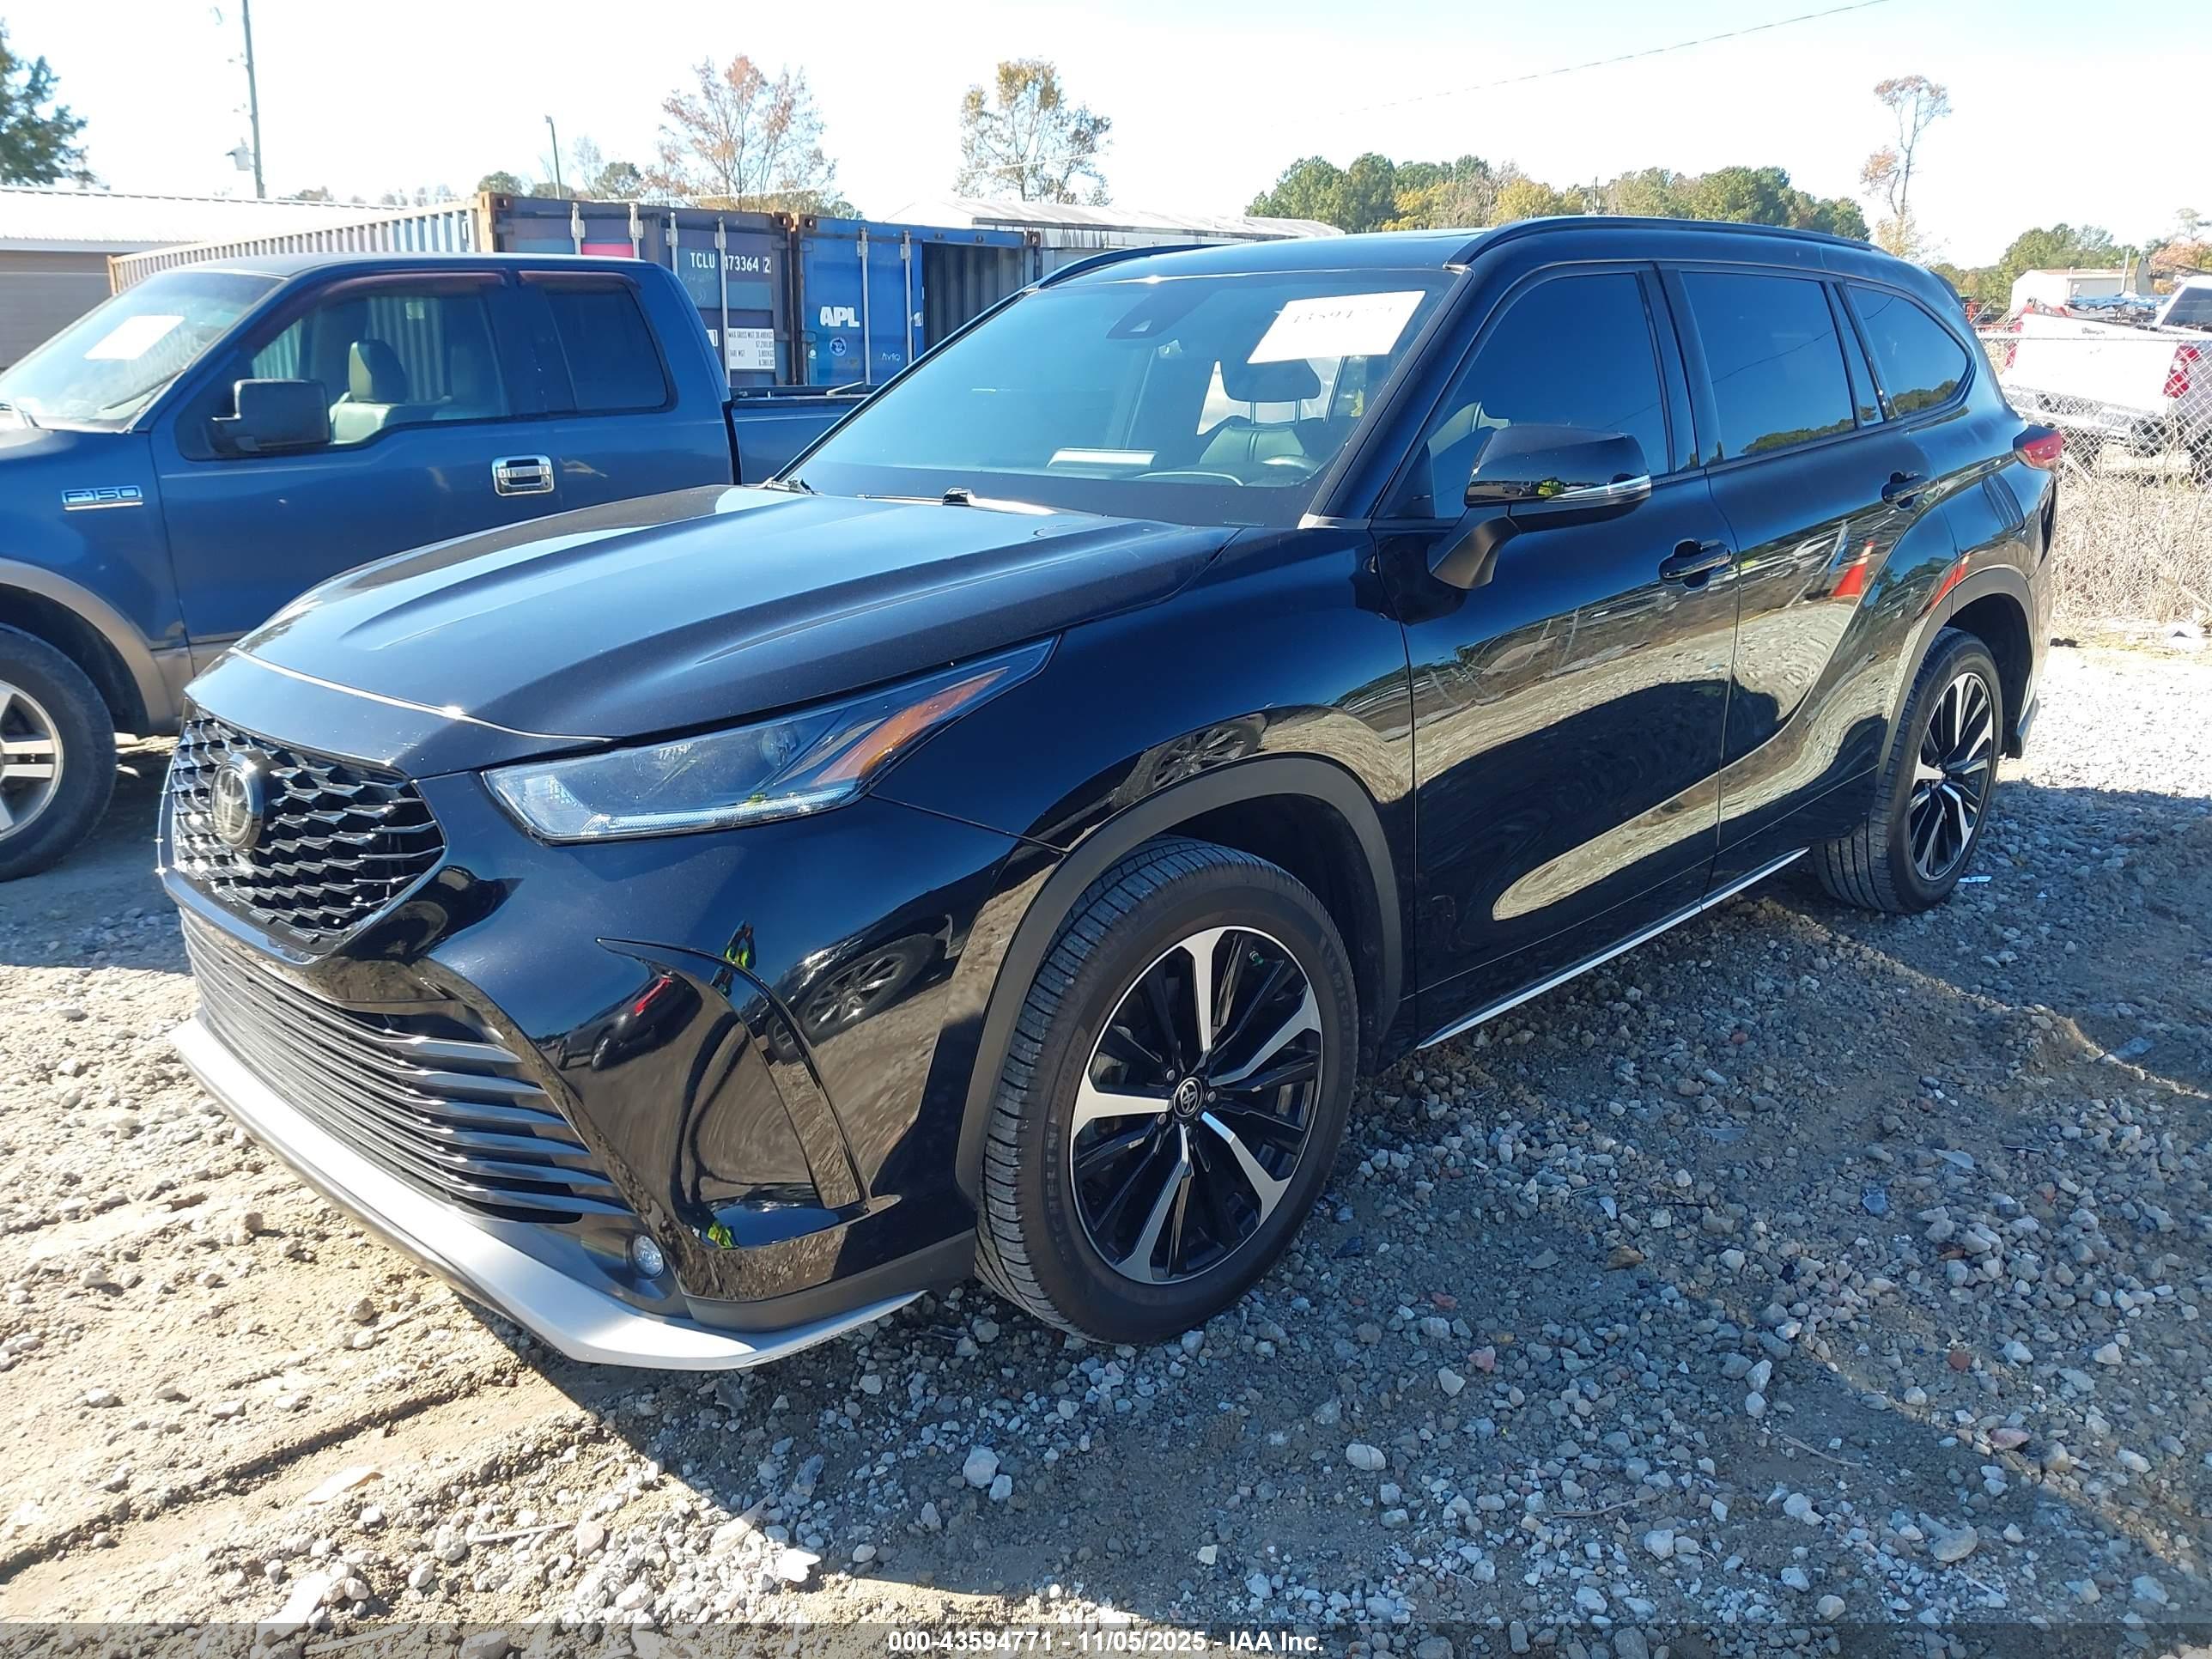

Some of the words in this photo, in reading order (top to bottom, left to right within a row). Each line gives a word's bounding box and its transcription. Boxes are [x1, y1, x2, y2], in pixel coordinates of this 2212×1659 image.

[690, 252, 715, 269] TCLU
[764, 258, 771, 273] 2
[820, 307, 860, 327] APL
[64, 487, 139, 503] F-150
